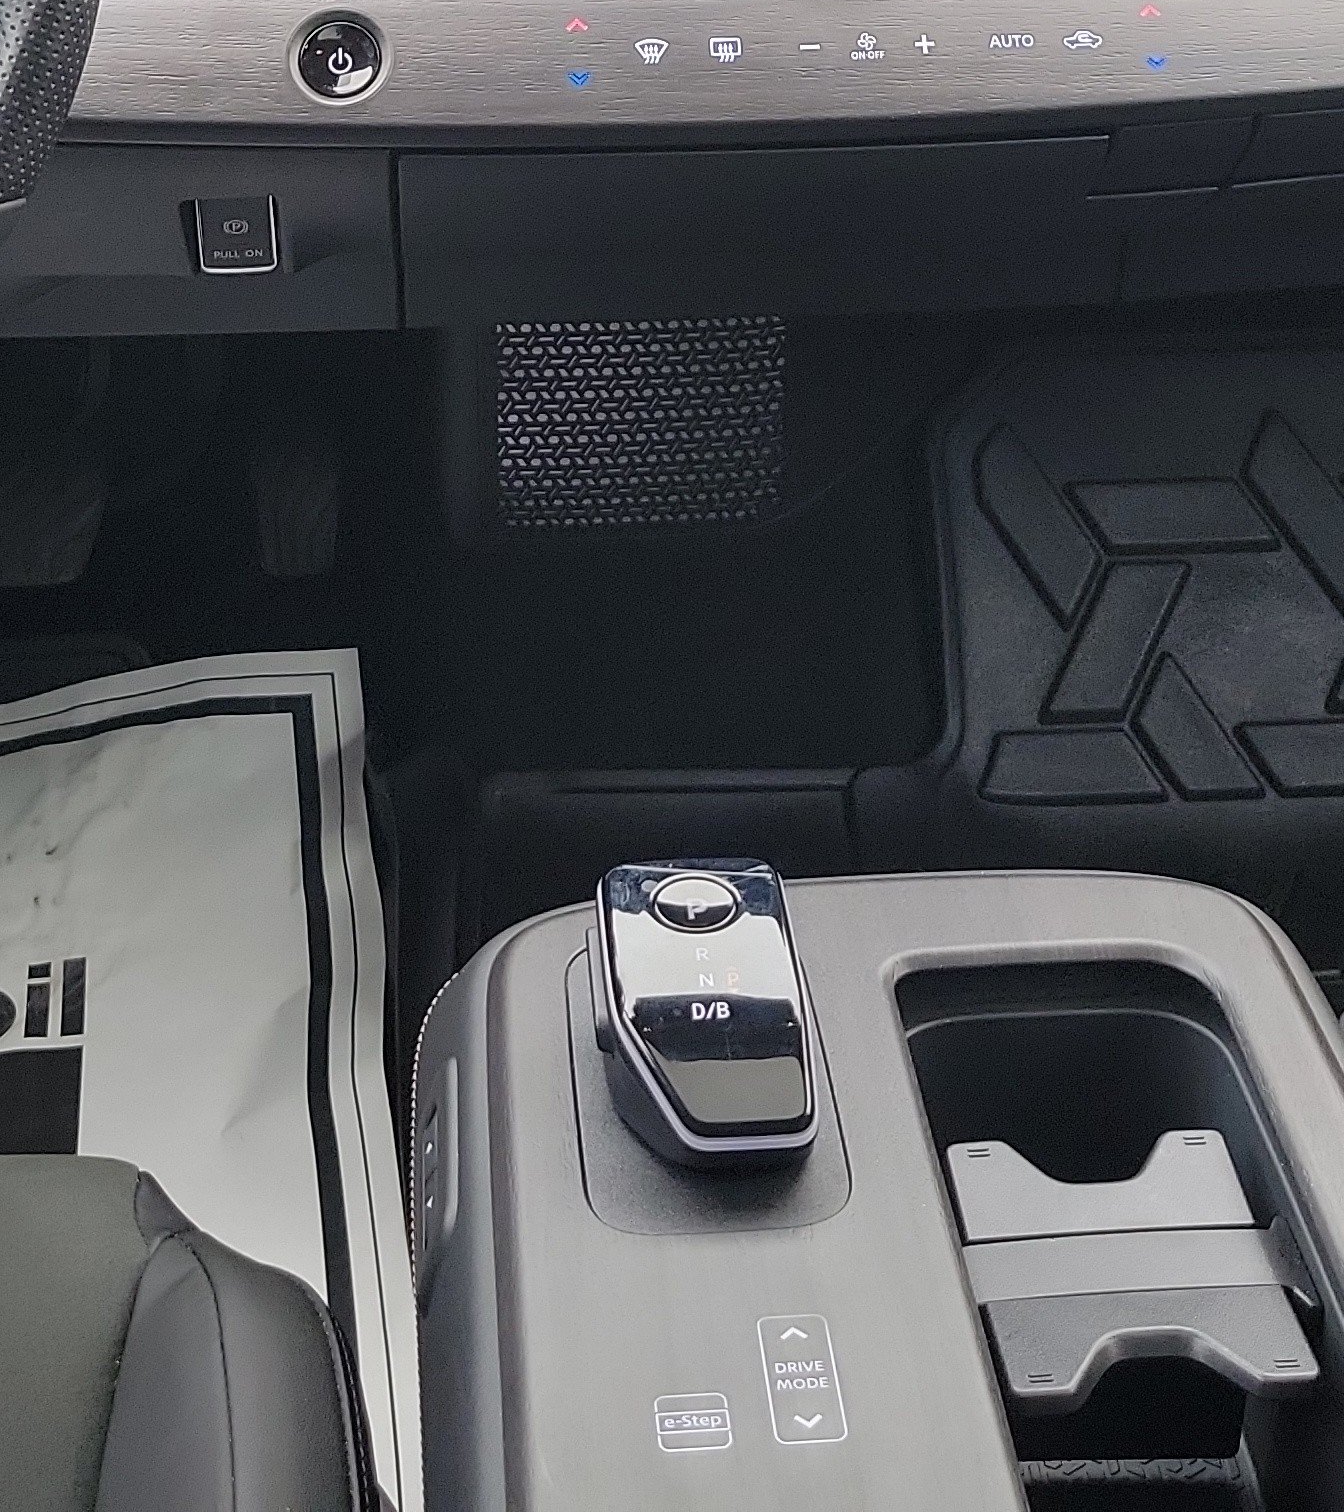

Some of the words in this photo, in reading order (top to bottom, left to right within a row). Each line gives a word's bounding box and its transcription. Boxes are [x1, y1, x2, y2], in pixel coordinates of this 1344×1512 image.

[989, 34, 1034, 49] AUTO
[213, 250, 240, 259] PULL
[245, 249, 263, 257] ON
[686, 898, 708, 920] P
[695, 947, 709, 961] R
[699, 972, 715, 987] N
[691, 1001, 731, 1021] D/B
[773, 1361, 825, 1374] DRIVE
[776, 1376, 830, 1390] MODE
[663, 1413, 723, 1430] e-Step
